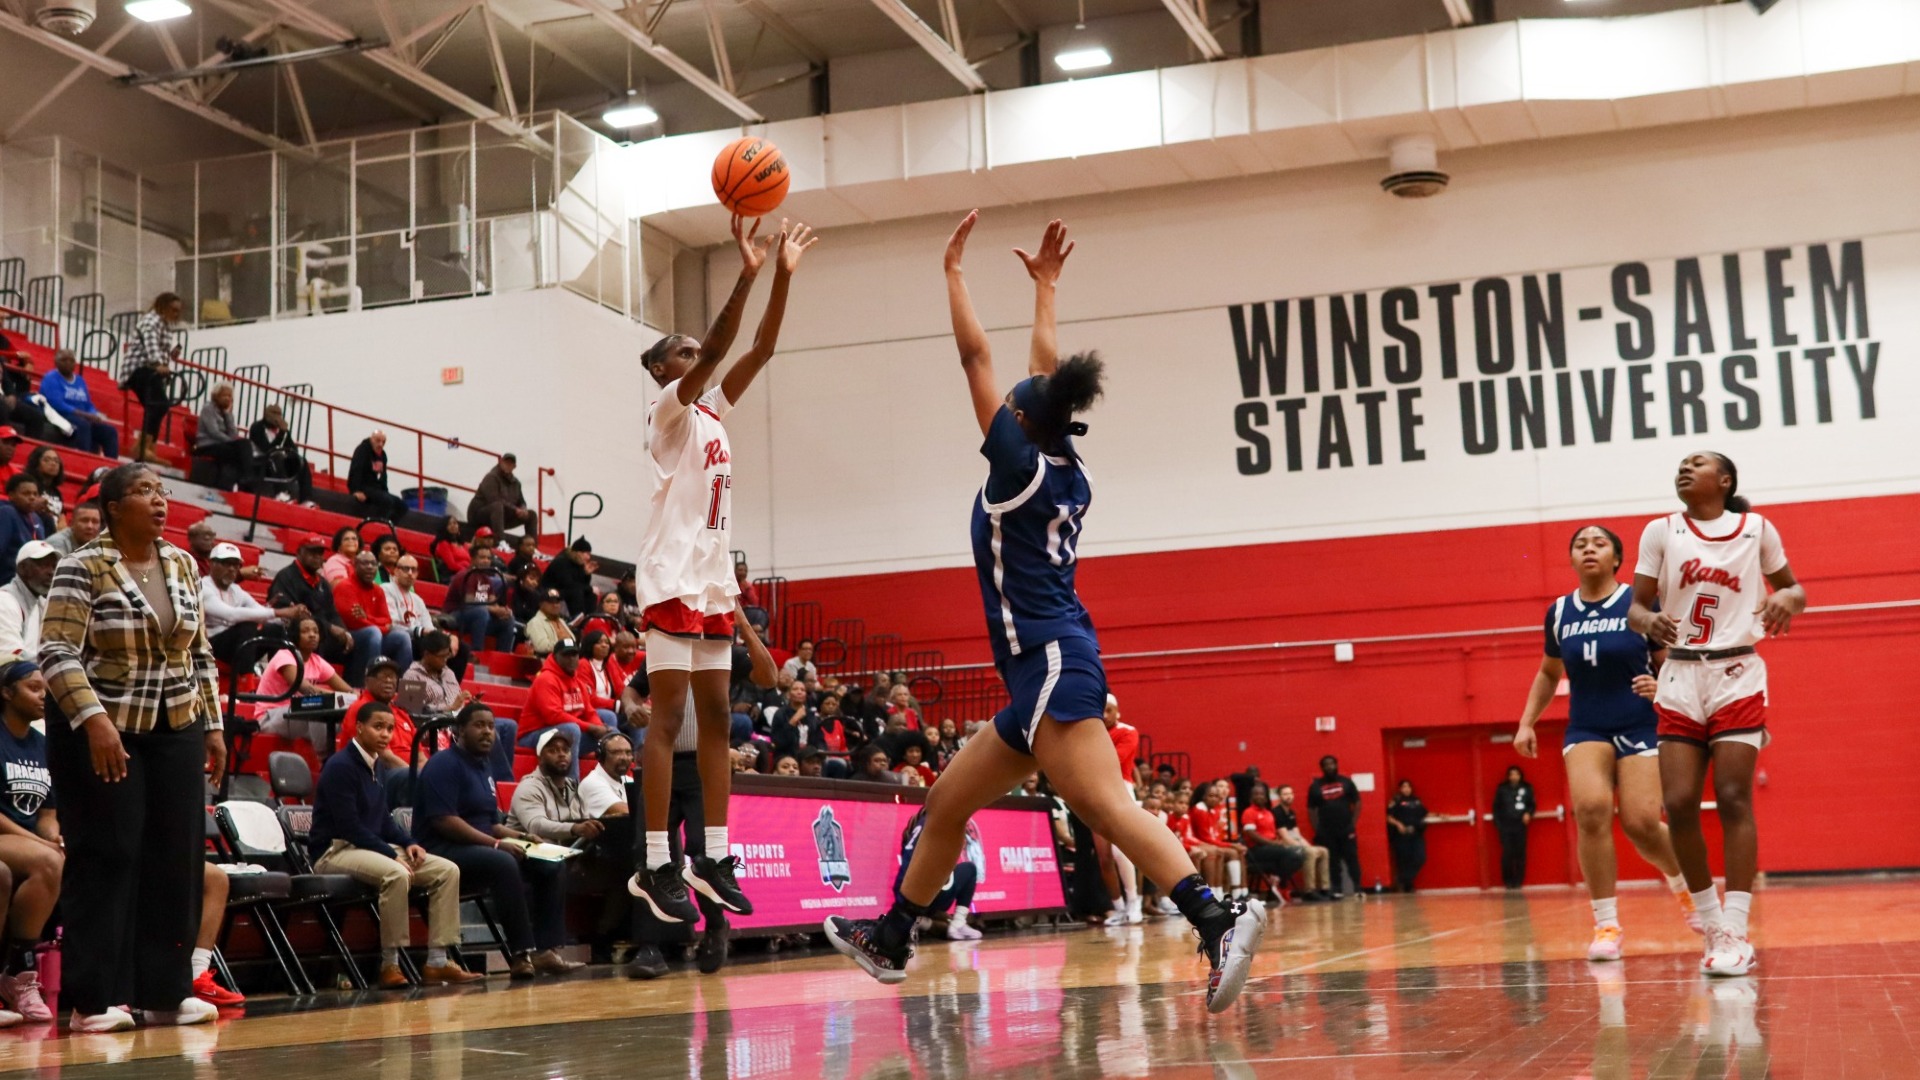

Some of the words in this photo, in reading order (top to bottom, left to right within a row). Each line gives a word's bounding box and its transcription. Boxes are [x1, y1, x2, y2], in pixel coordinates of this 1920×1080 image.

[1228, 240, 1870, 399] WINSTON-SALEM
[1234, 387, 1426, 476] STATE
[1459, 342, 1881, 456] UNIVERSITY
[1046, 504, 1085, 567] 11
[1679, 558, 1741, 593] Rams
[1561, 617, 1628, 640] DRAGONS
[1685, 592, 1720, 647] 5
[1583, 640, 1598, 667] 4
[745, 844, 785, 859] SPORTS
[746, 863, 791, 879] NETWORK
